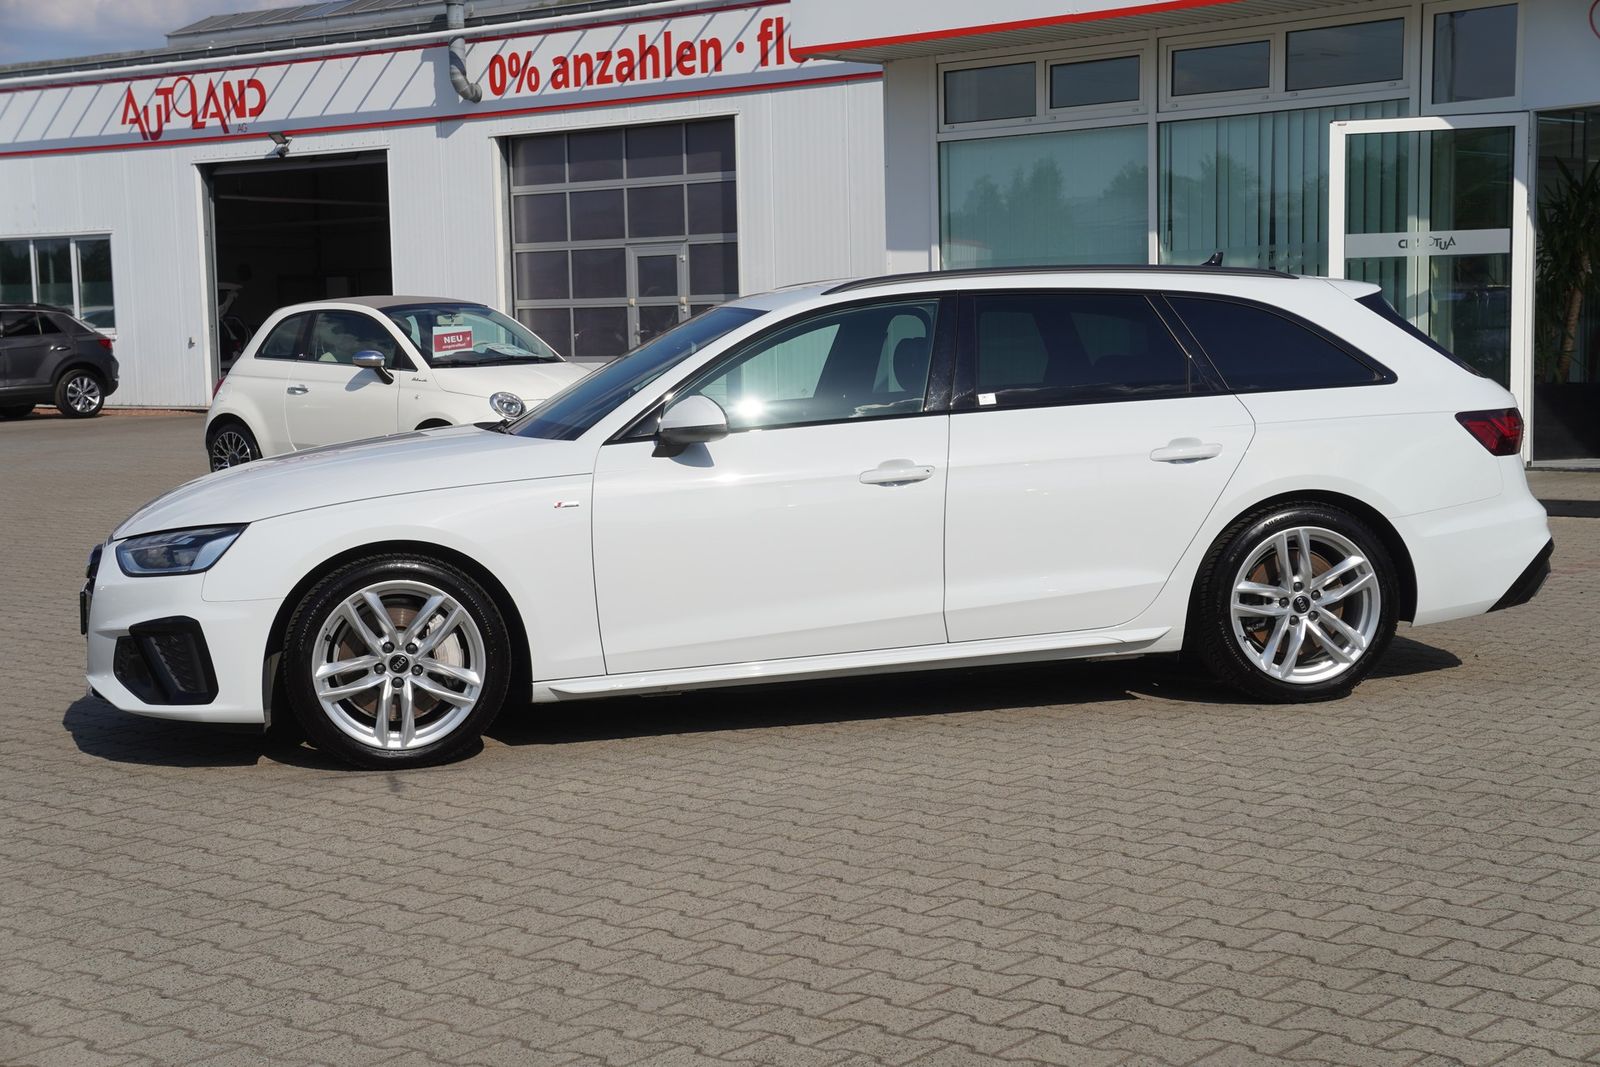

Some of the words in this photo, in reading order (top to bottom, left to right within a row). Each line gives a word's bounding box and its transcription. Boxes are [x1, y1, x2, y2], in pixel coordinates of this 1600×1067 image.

[488, 51, 540, 96] 0%
[550, 31, 722, 90] anzahlen
[757, 16, 809, 67] fl
[443, 334, 463, 344] NEU
